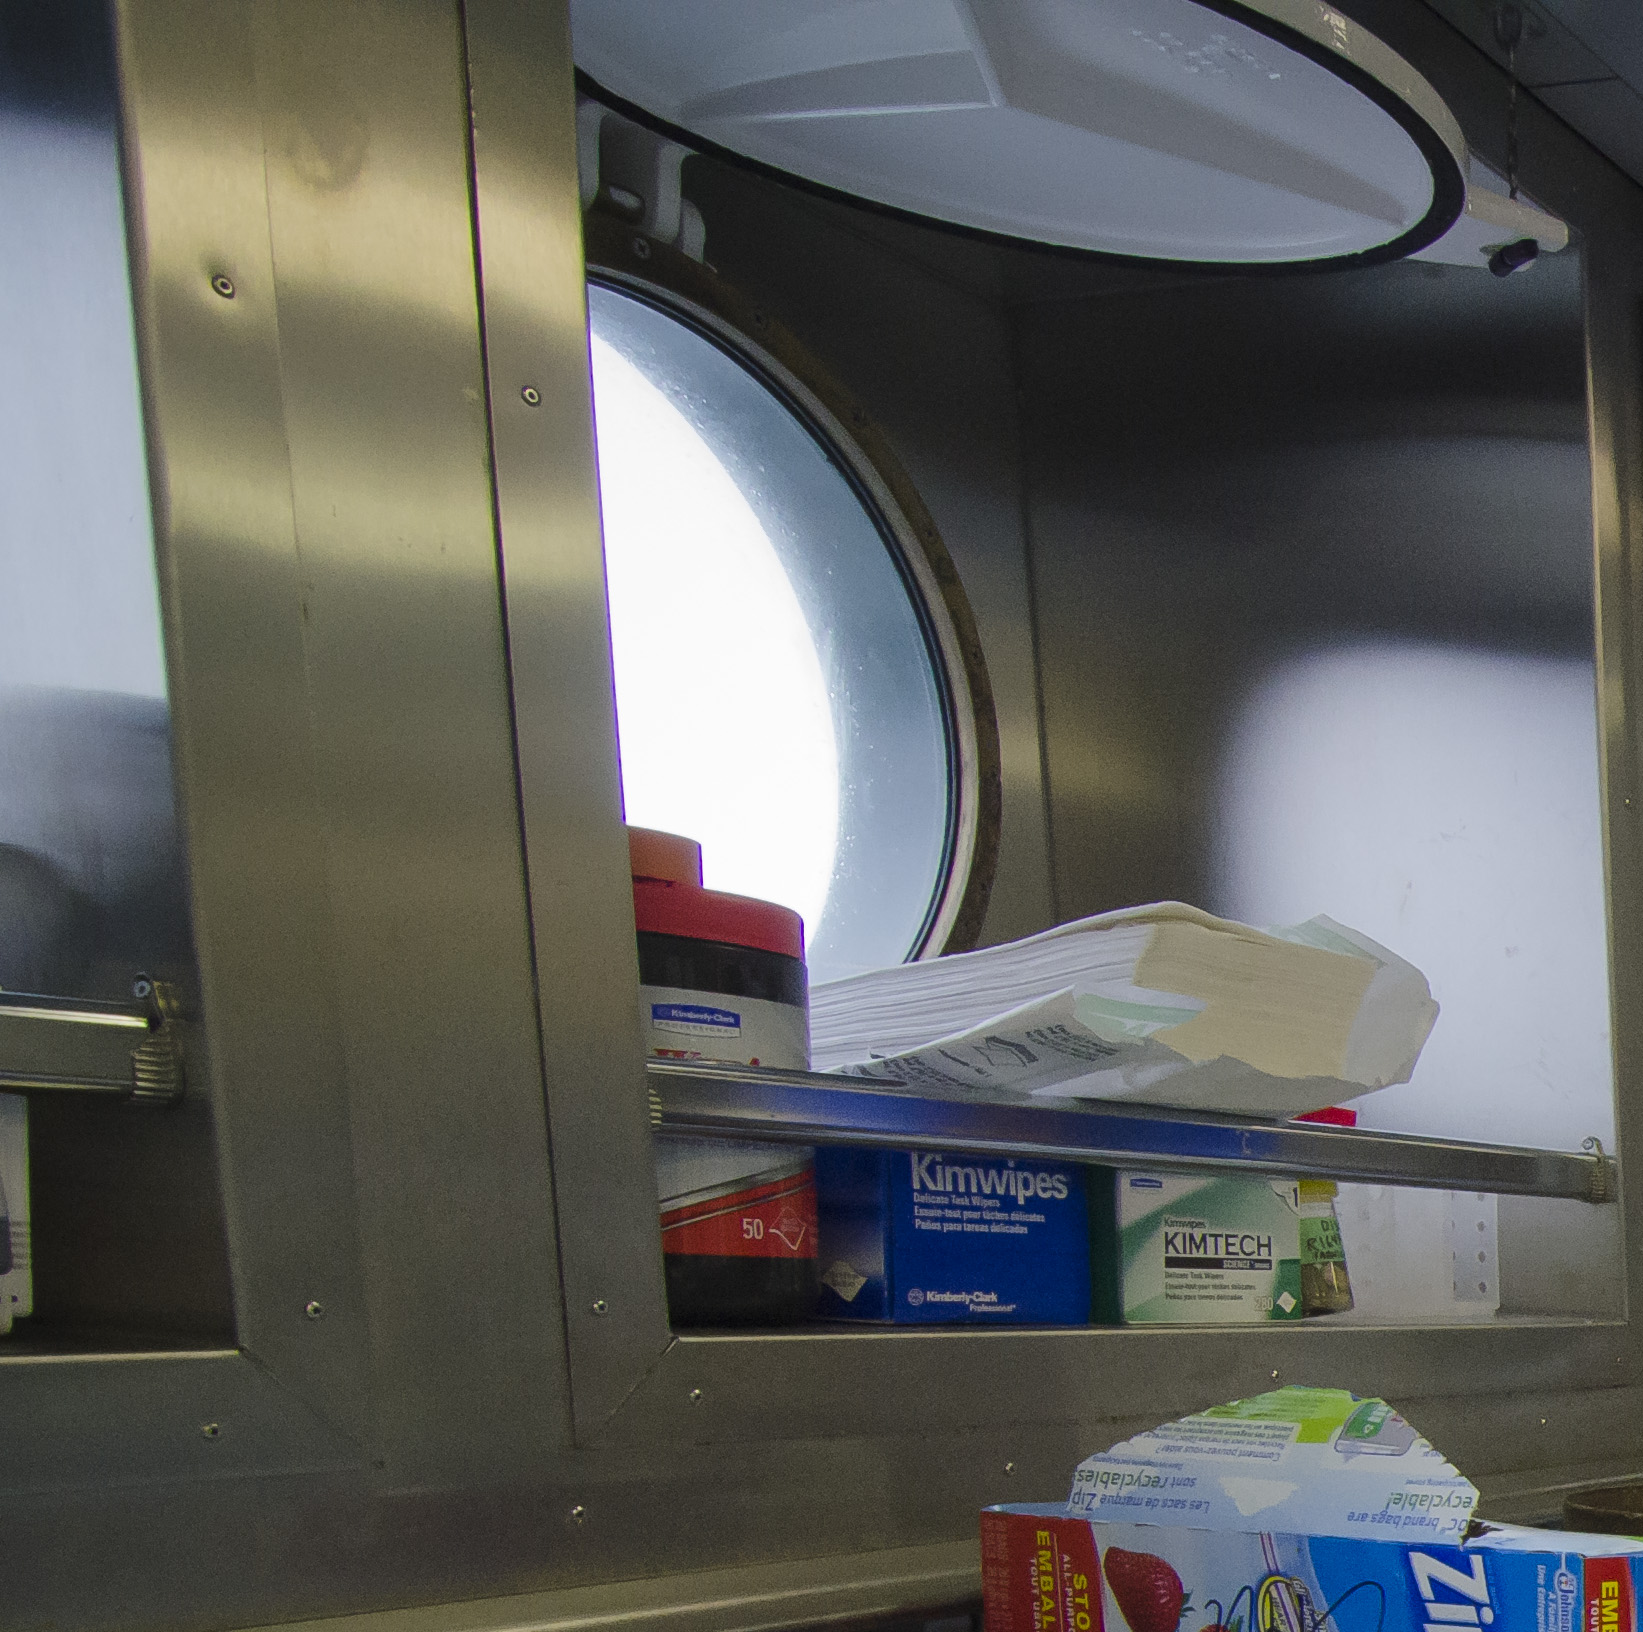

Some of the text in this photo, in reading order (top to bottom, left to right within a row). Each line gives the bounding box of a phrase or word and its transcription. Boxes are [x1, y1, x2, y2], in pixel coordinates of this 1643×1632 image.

[911, 1151, 1068, 1205] Kimwipes
[742, 1218, 764, 1240] 50
[1164, 1231, 1272, 1257] KIMTECH
[926, 1291, 998, 1304] Kimberly-Clark
[1238, 1450, 1280, 1462] Comment
[1172, 1476, 1197, 1489] sont
[1072, 1486, 1210, 1514] Les sacs de marque Zip
[1384, 1490, 1474, 1512] ecyclable!
[1347, 1511, 1368, 1522] are
[1372, 1510, 1402, 1529] bags
[1402, 1515, 1440, 1531] brand
[1029, 1557, 1040, 1595] TOUT
[1590, 1598, 1599, 1632] TOUT
